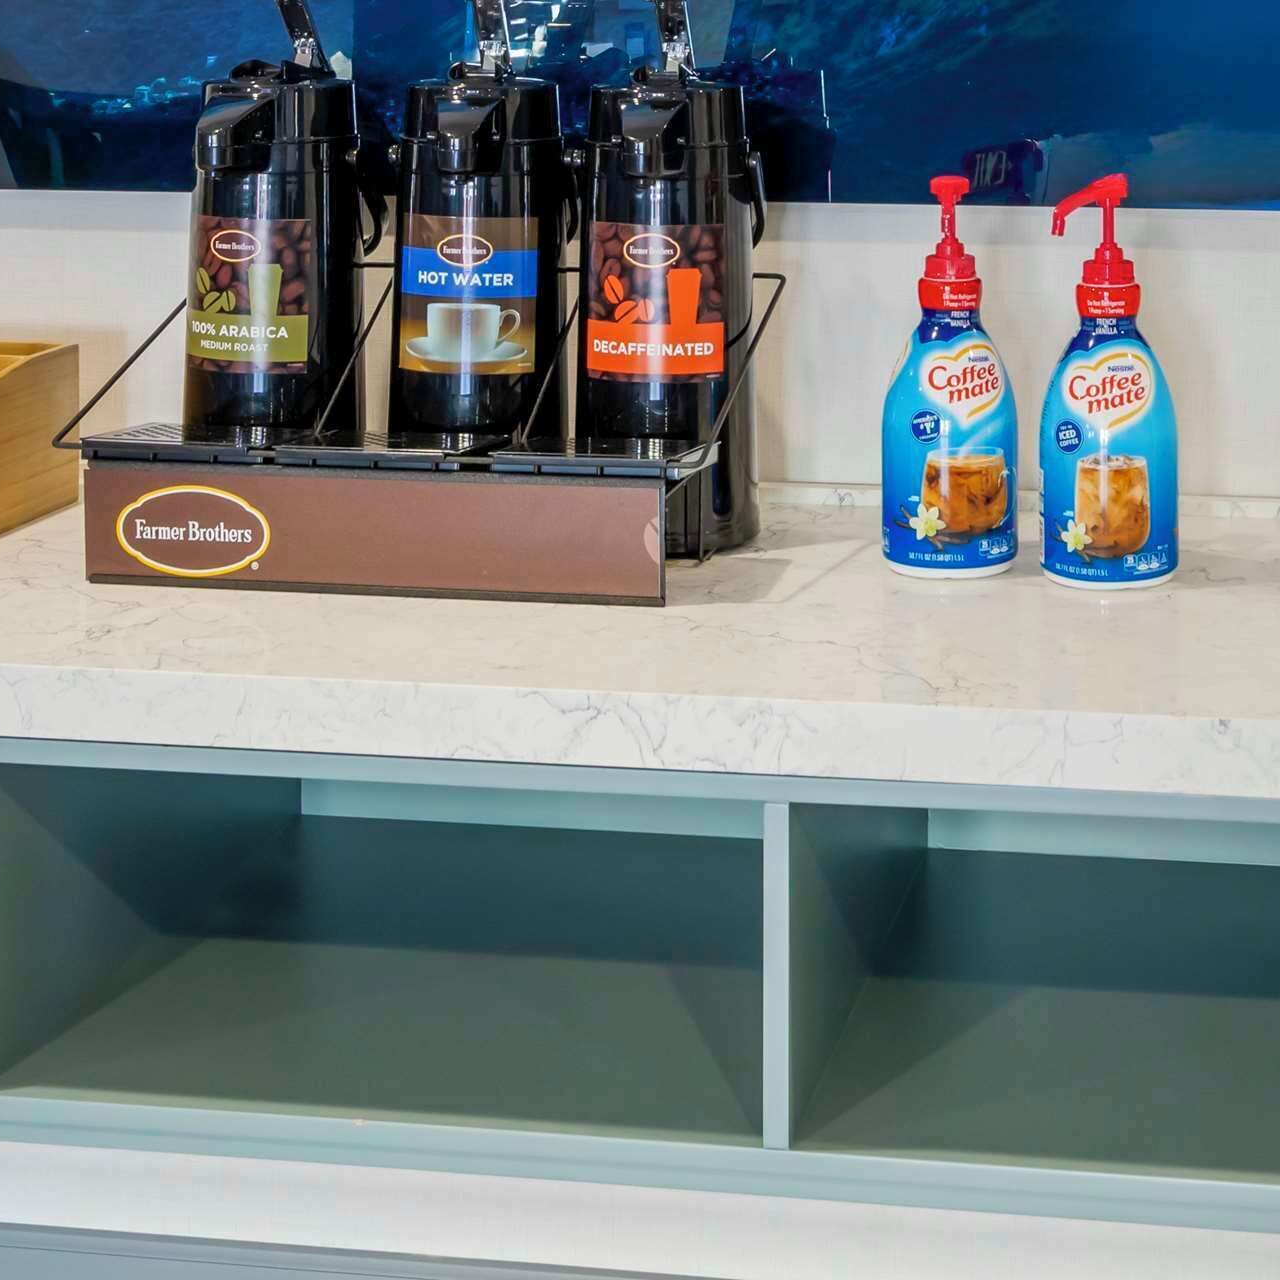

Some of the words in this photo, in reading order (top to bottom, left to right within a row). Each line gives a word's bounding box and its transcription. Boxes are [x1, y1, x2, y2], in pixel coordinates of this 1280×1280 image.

[417, 270, 448, 286] HOT
[452, 272, 514, 287] WATER
[950, 310, 970, 319] FRENCH
[1096, 318, 1117, 326] FRENCH
[191, 320, 216, 335] 100%
[219, 324, 288, 339] ARABICA
[950, 319, 971, 328] VANILLA
[1095, 326, 1118, 335] VANILLA
[200, 339, 232, 351] MEDIUM
[233, 342, 269, 352] ROAST
[593, 338, 714, 357] DECAFFEINATED
[927, 363, 996, 391] Coffee
[948, 375, 999, 404] mate
[1068, 372, 1142, 401] Coffee
[1087, 385, 1145, 414] mate
[1058, 429, 1076, 440] ICED
[1059, 437, 1079, 447] COFFEE
[134, 519, 186, 541] Farmer
[188, 521, 252, 543] Brothers
